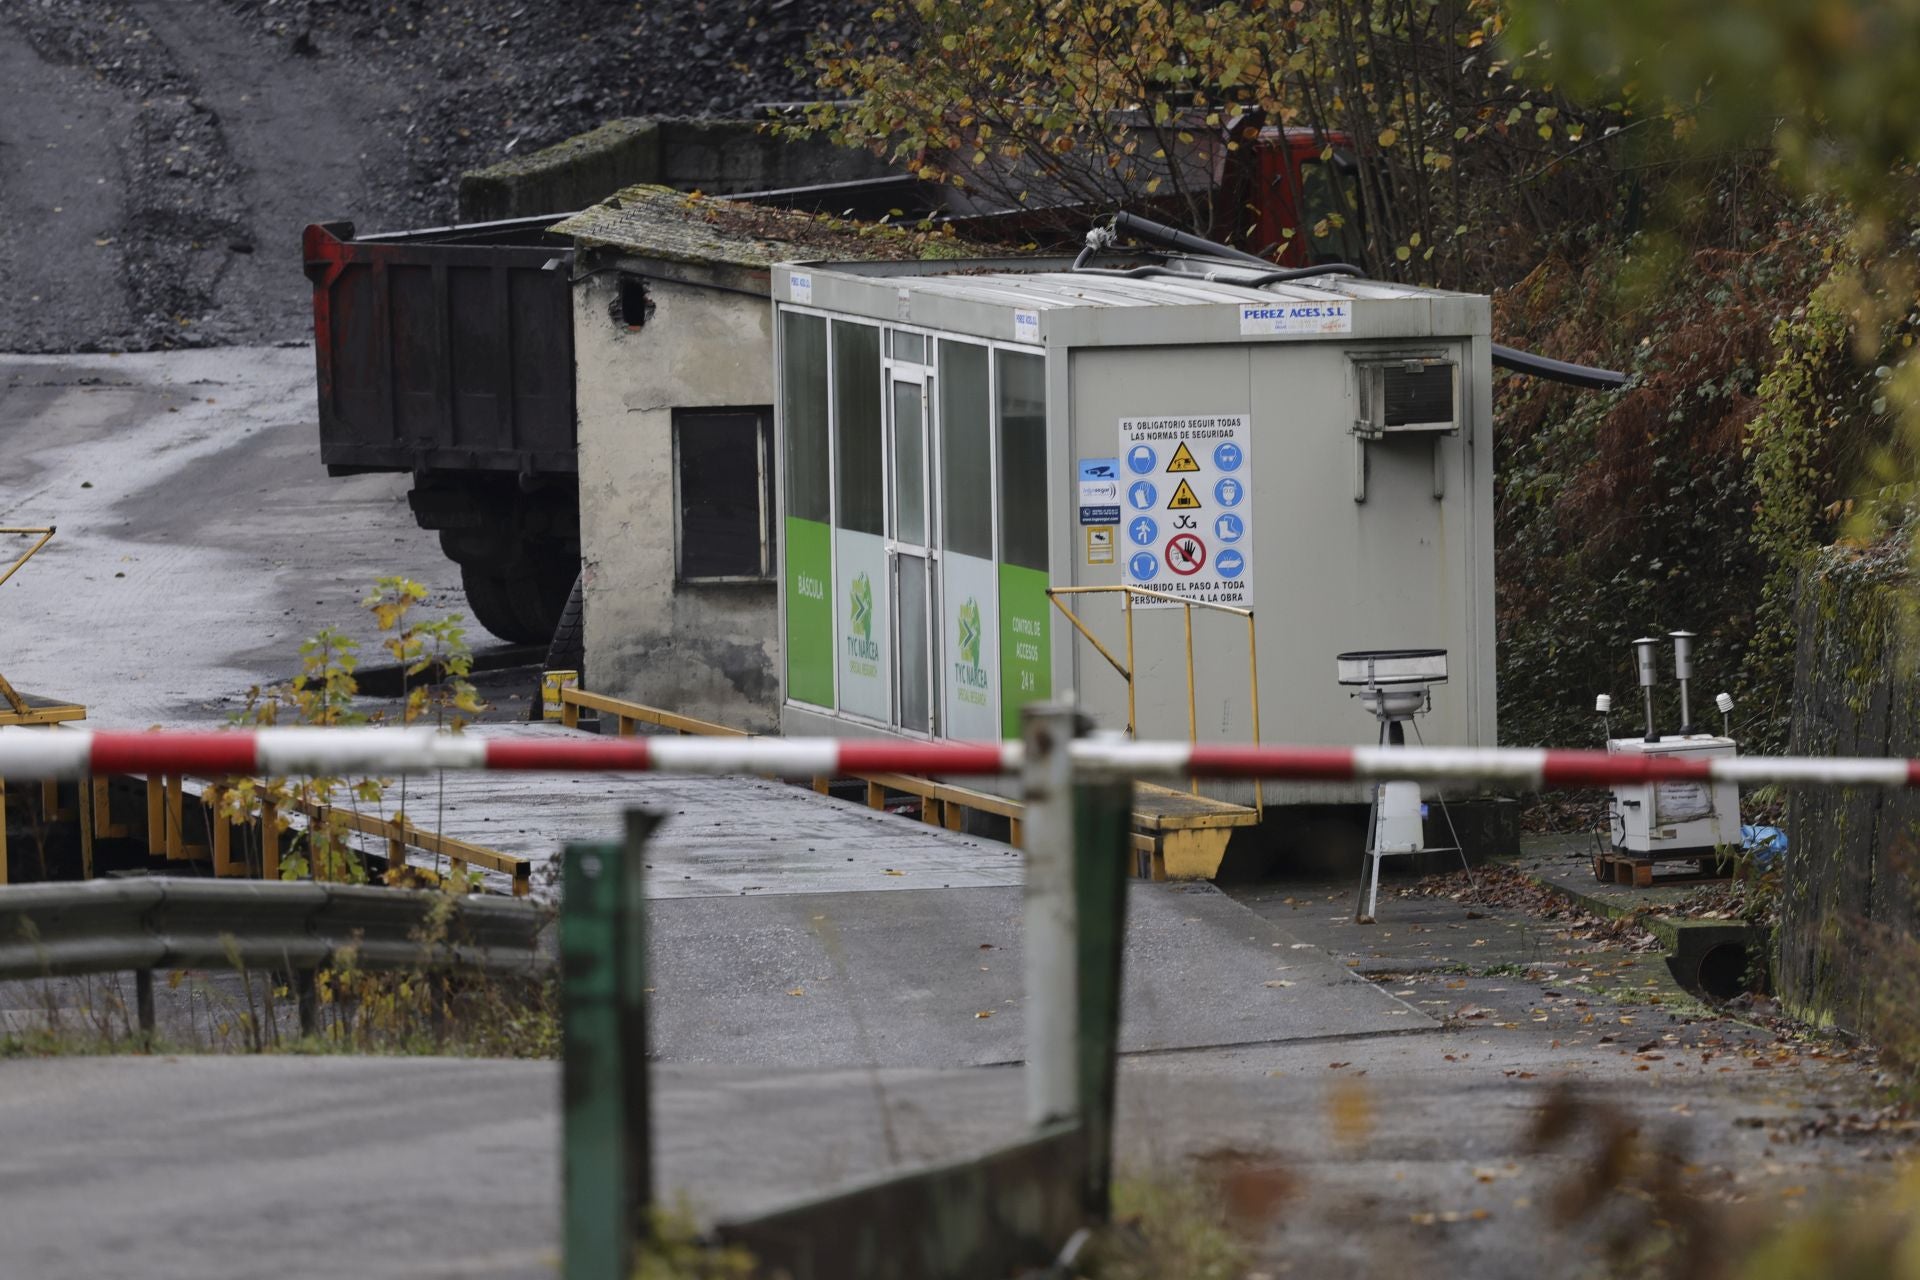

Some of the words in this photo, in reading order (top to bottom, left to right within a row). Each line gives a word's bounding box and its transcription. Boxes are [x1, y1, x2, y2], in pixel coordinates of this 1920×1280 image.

[1244, 309, 1284, 319] PEREZ
[1123, 422, 1133, 431] ES
[1137, 420, 1186, 430] OBLIGATORIO
[1188, 419, 1215, 428] SEGUIR
[1217, 418, 1241, 427] TODAS
[1131, 432, 1145, 441] LAS
[1147, 431, 1178, 440] NORMAS
[1180, 430, 1190, 439] DE
[1192, 429, 1234, 438] SEGURIDAD
[798, 571, 824, 600] BÁSCULA
[1176, 582, 1187, 591] EL
[1189, 581, 1211, 590] PASO
[1213, 581, 1220, 589] A
[1222, 581, 1245, 589] TODA
[1208, 593, 1218, 602] LA
[1220, 593, 1243, 602] OBRA
[1012, 617, 1034, 635] CONTROL
[1034, 621, 1041, 636] DE
[847, 636, 858, 656] TYC
[1016, 642, 1038, 661] ACCESOS
[955, 663, 966, 684] TYC
